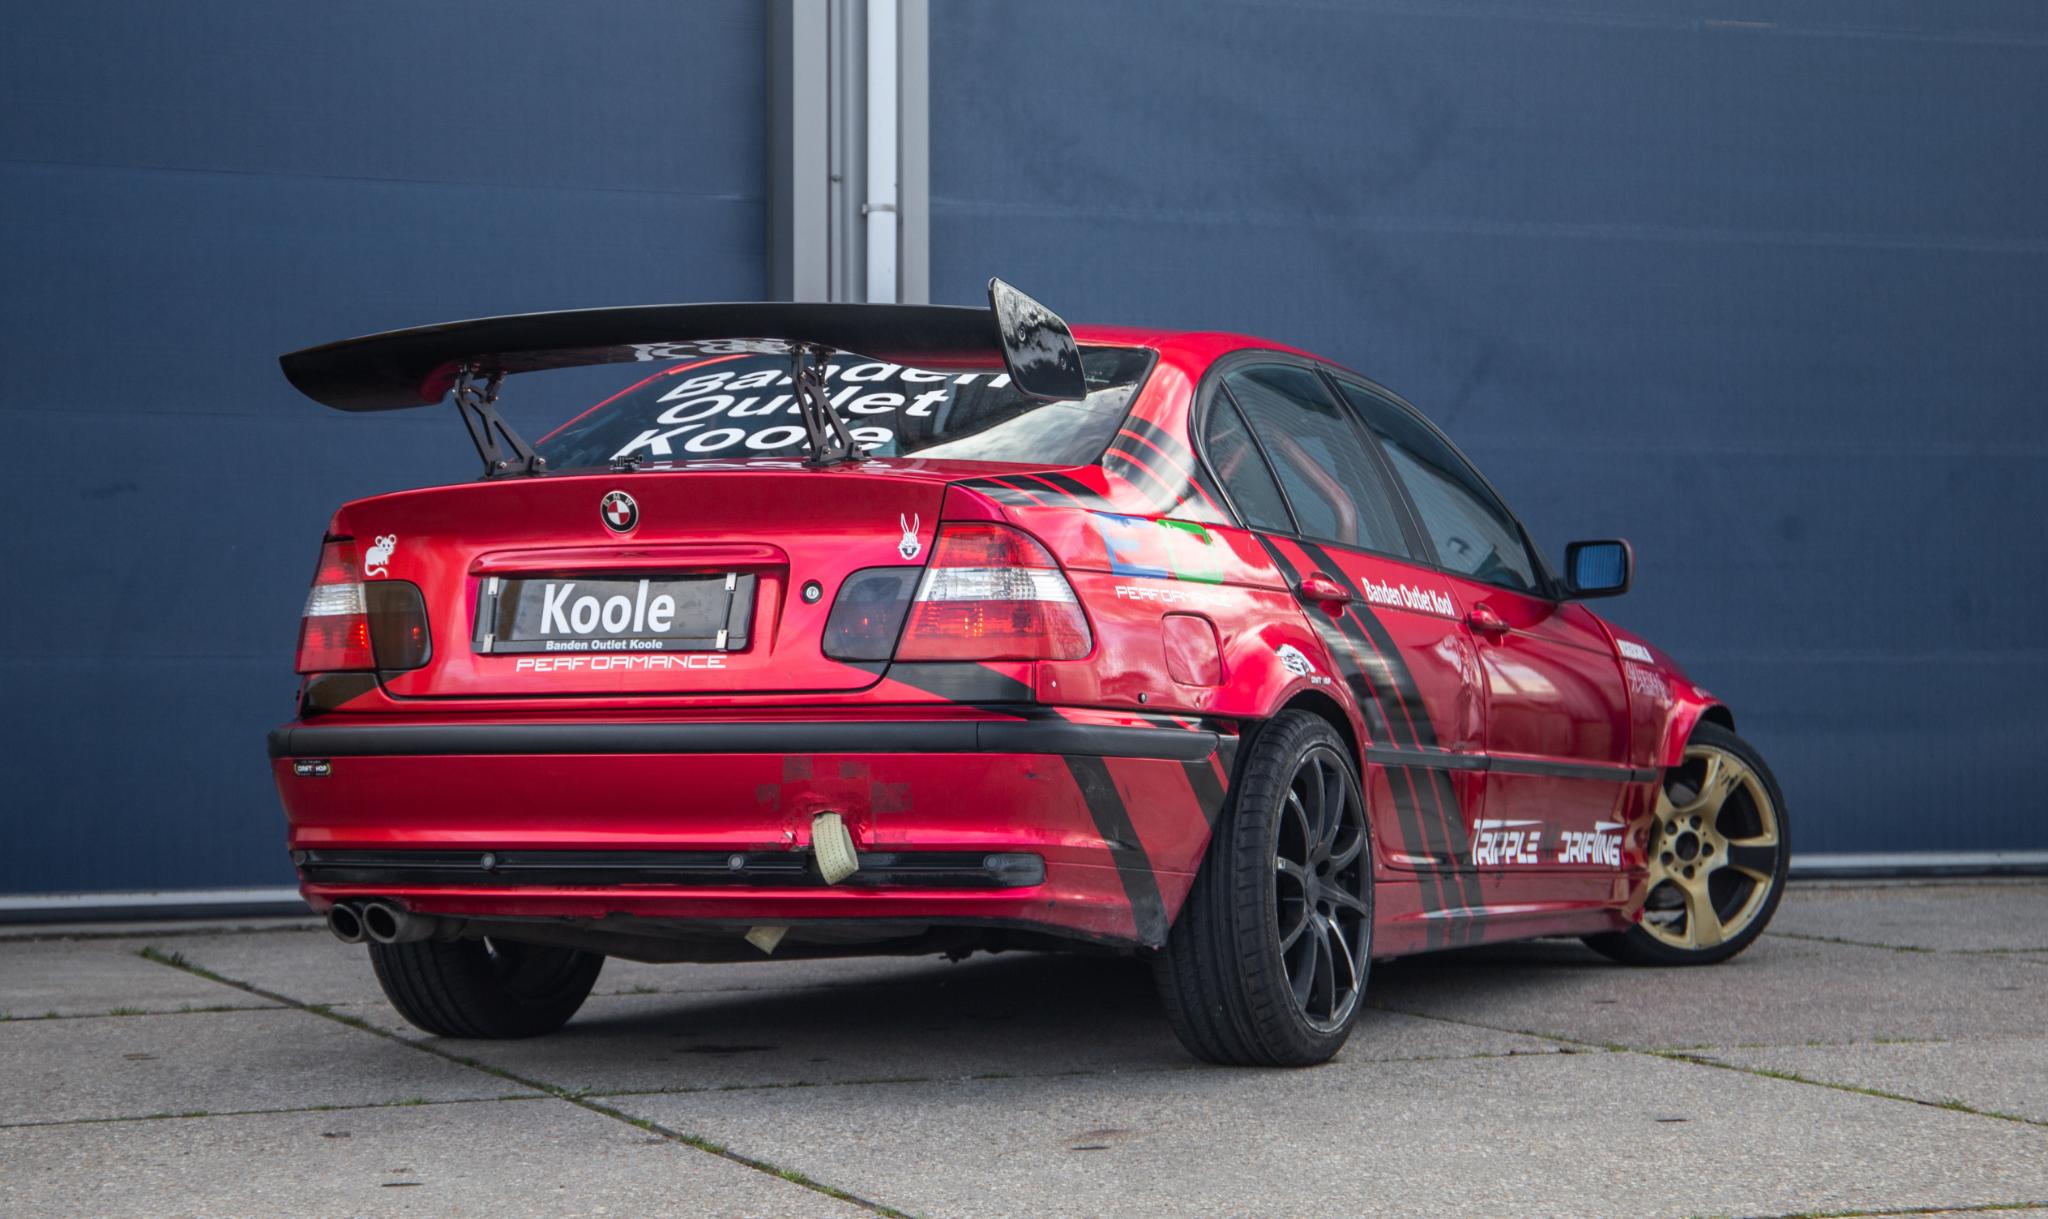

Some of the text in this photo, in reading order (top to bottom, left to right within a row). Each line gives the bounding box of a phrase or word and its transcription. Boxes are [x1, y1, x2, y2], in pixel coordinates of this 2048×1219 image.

[540, 579, 676, 634] Koole
[1115, 585, 1232, 607] PERFORA
[1361, 577, 1403, 607] Banden
[1400, 584, 1435, 613] Outlet
[545, 639, 663, 650] Banden Outlet Koole
[516, 654, 728, 672] PERFORMANCE
[1472, 818, 1543, 866] TRIPPLE
